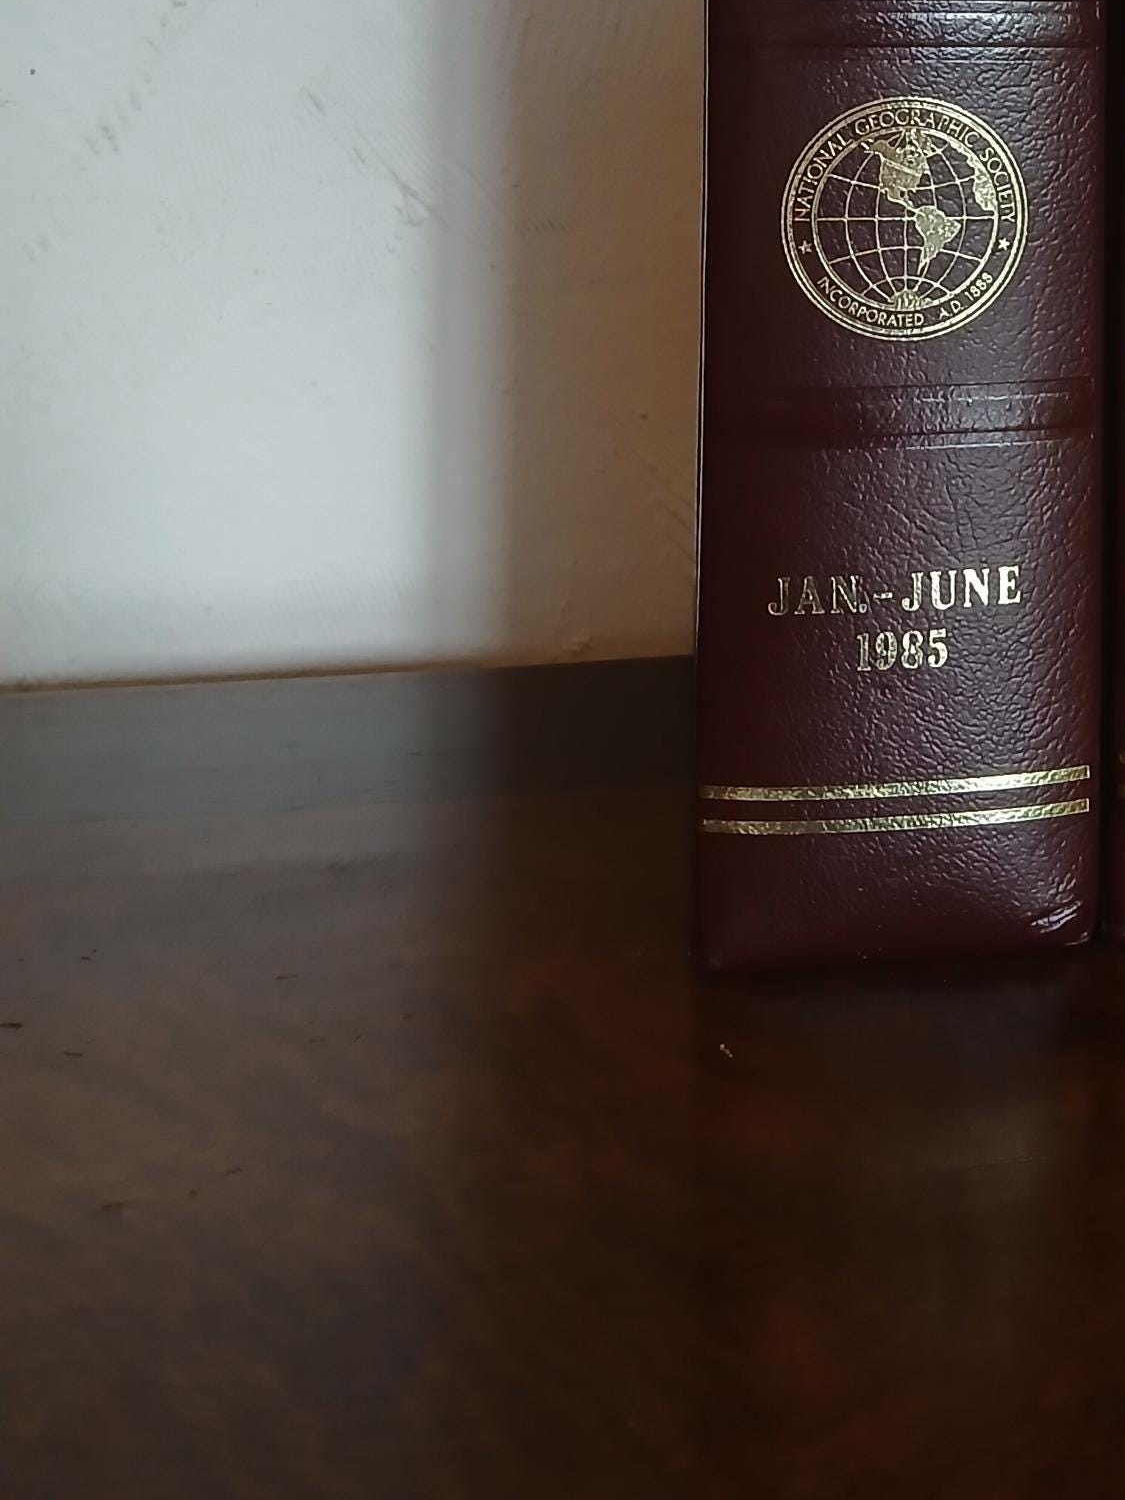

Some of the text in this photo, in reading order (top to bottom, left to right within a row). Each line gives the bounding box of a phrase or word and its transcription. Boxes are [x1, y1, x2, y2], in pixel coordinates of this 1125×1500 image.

[794, 109, 1015, 223] NATIONAL GEOGRAPHIC SOCIETY
[817, 272, 993, 327] INCORPORATED A.D. 1888
[855, 627, 949, 672] 1985
